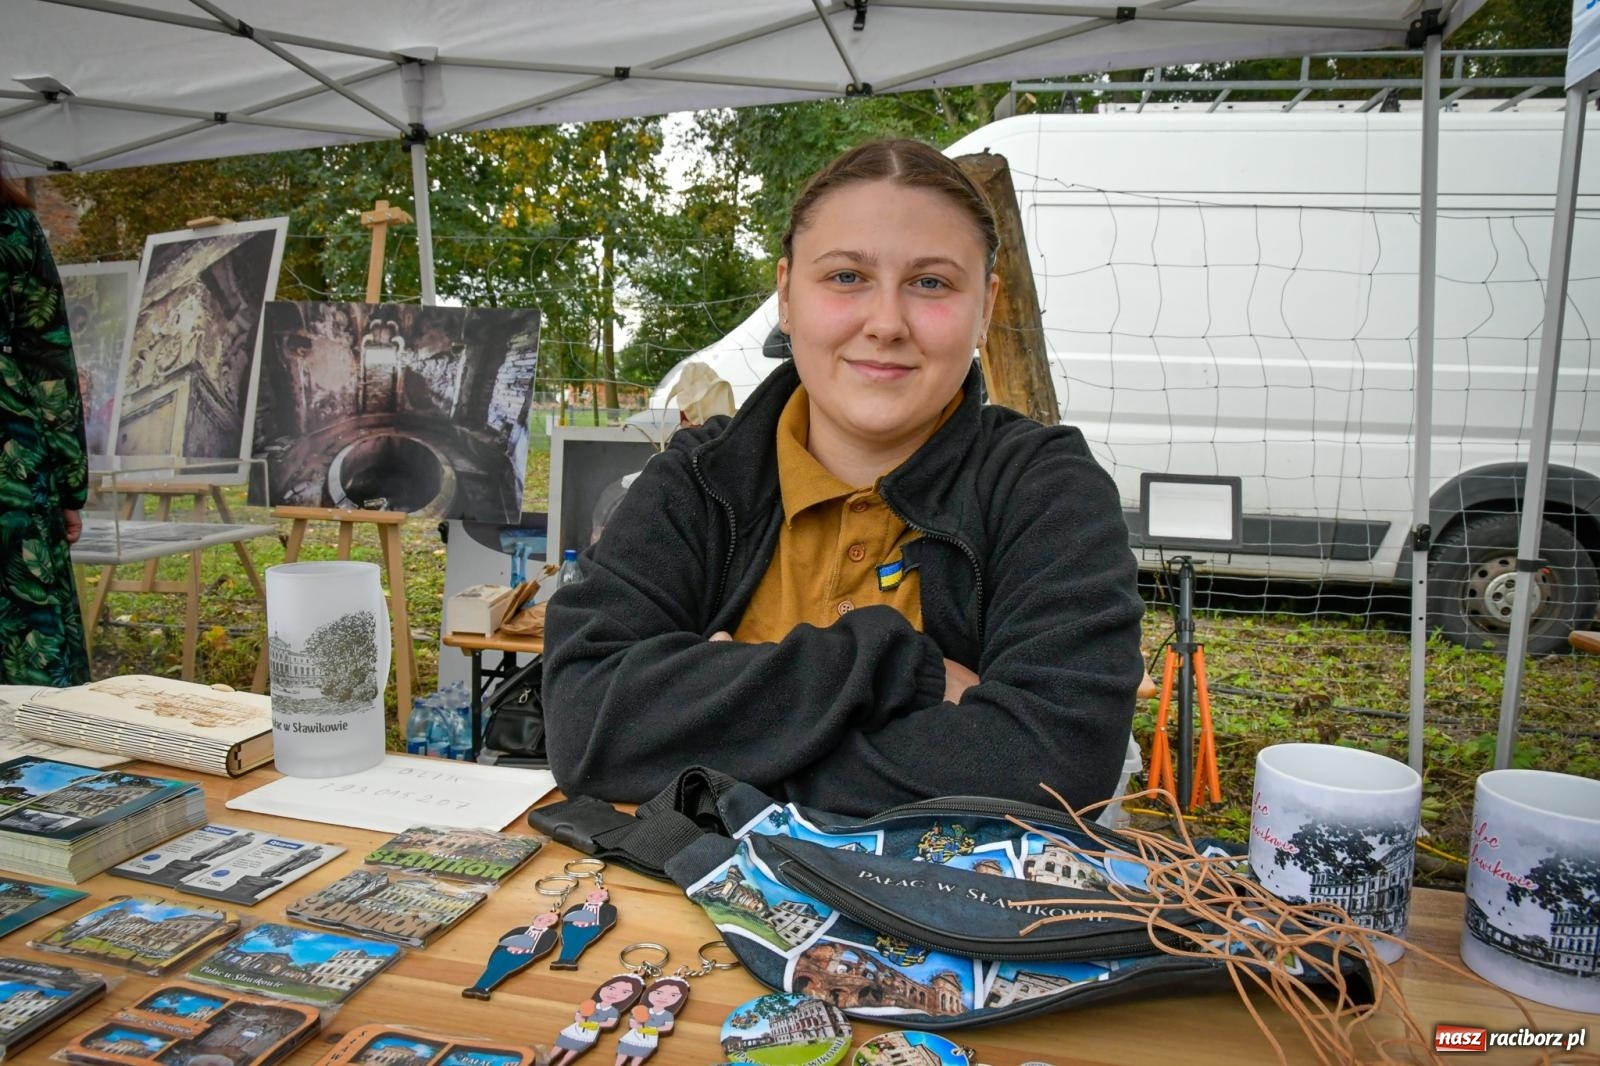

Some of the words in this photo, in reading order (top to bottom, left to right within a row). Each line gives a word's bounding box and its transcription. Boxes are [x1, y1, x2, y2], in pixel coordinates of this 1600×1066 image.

[293, 720, 348, 734] Sławikowie
[858, 870, 925, 888] PAŁAC
[937, 882, 956, 893] W
